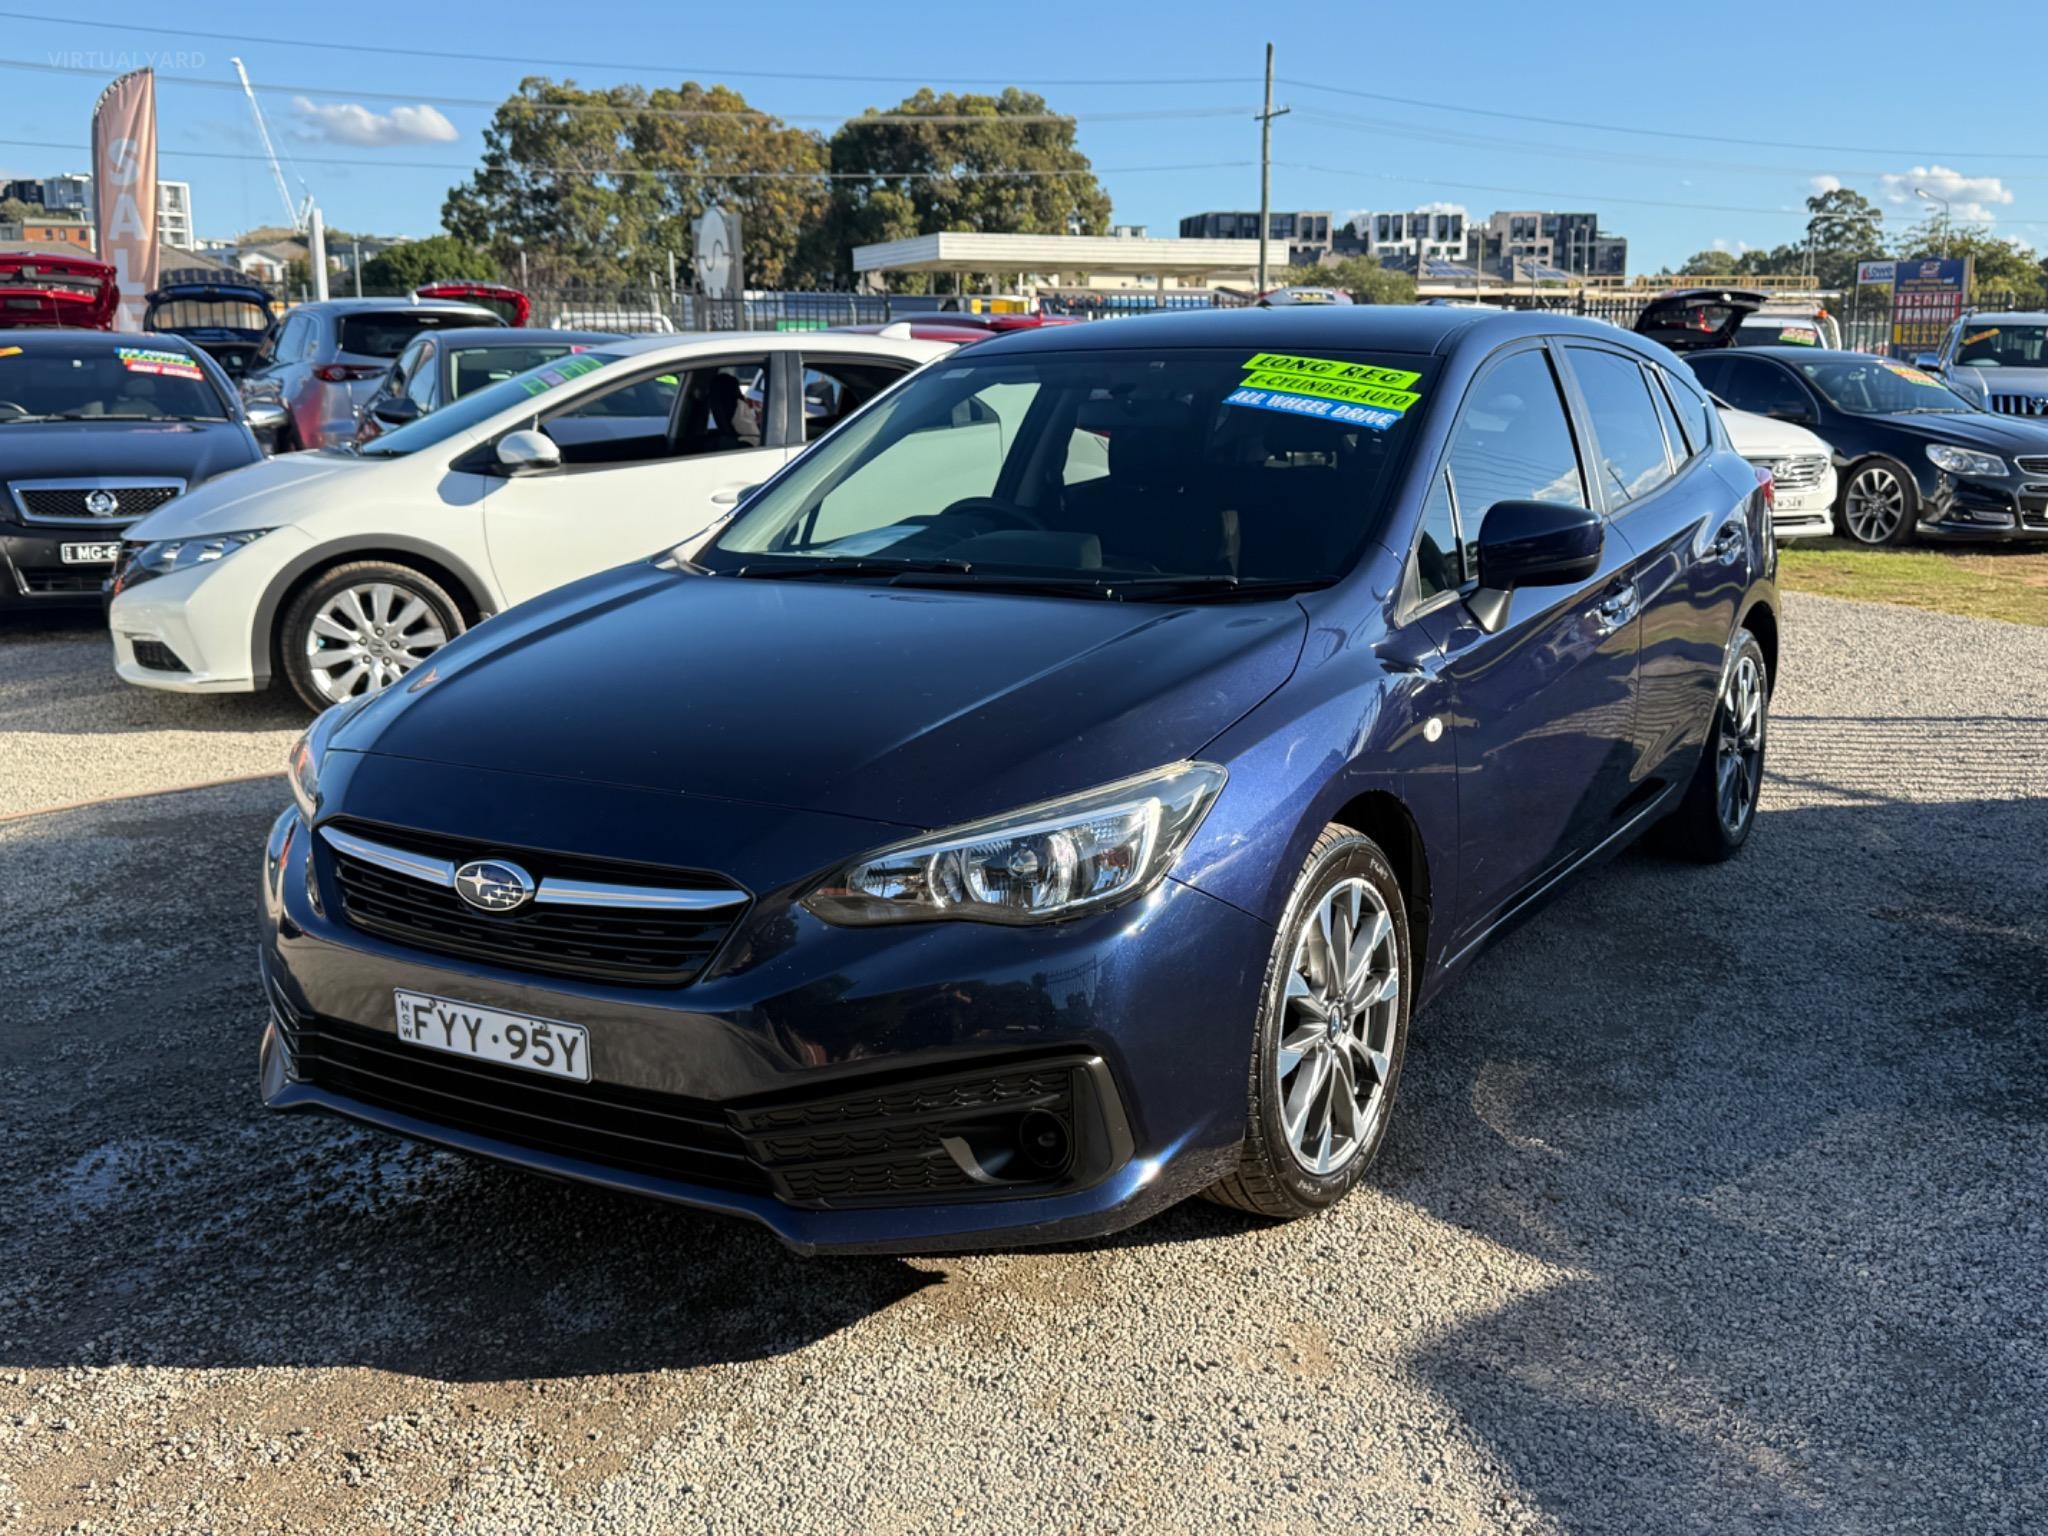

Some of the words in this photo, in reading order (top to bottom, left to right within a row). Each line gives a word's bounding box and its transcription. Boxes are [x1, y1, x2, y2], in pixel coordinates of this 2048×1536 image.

[1256, 356, 1334, 373] LONG
[1339, 366, 1407, 384] REG
[1227, 390, 1267, 405] ALL
[1265, 393, 1333, 416] WHEEL
[1330, 405, 1400, 428] DRIVE
[1357, 391, 1411, 406] AUTO
